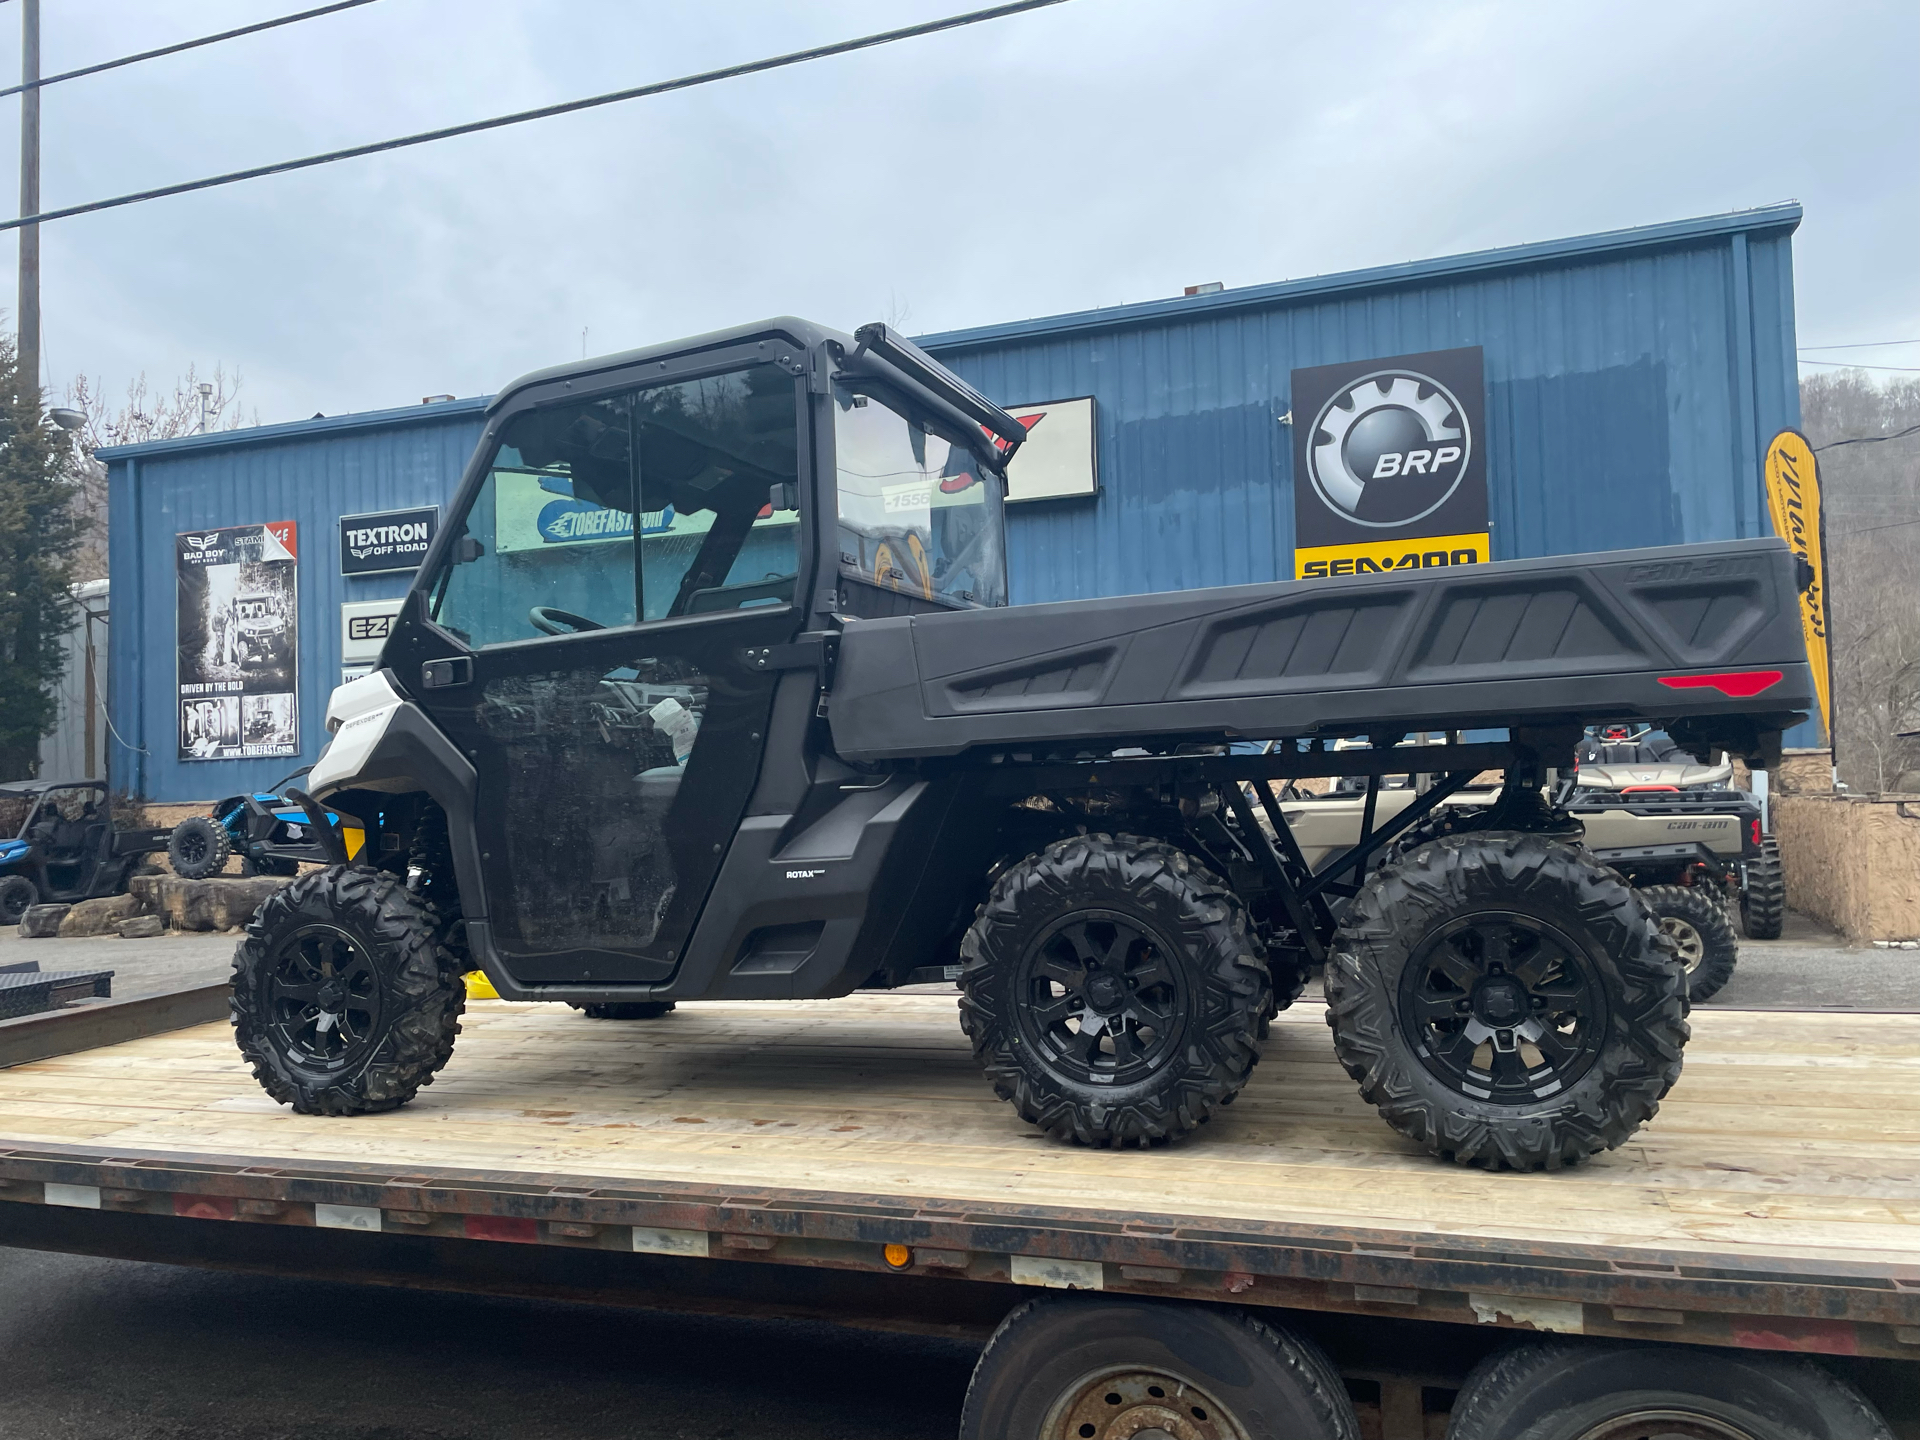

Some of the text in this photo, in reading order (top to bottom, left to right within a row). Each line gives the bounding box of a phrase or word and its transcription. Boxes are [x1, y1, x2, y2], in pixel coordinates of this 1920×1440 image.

[1372, 446, 1461, 479] BRP
[346, 522, 428, 547] TEXTRON
[183, 549, 225, 560] BAD BOY
[373, 542, 428, 555] OFF ROAD
[180, 680, 243, 694] DRIVEN BY THE BOLD
[786, 870, 814, 879] ROTAX
